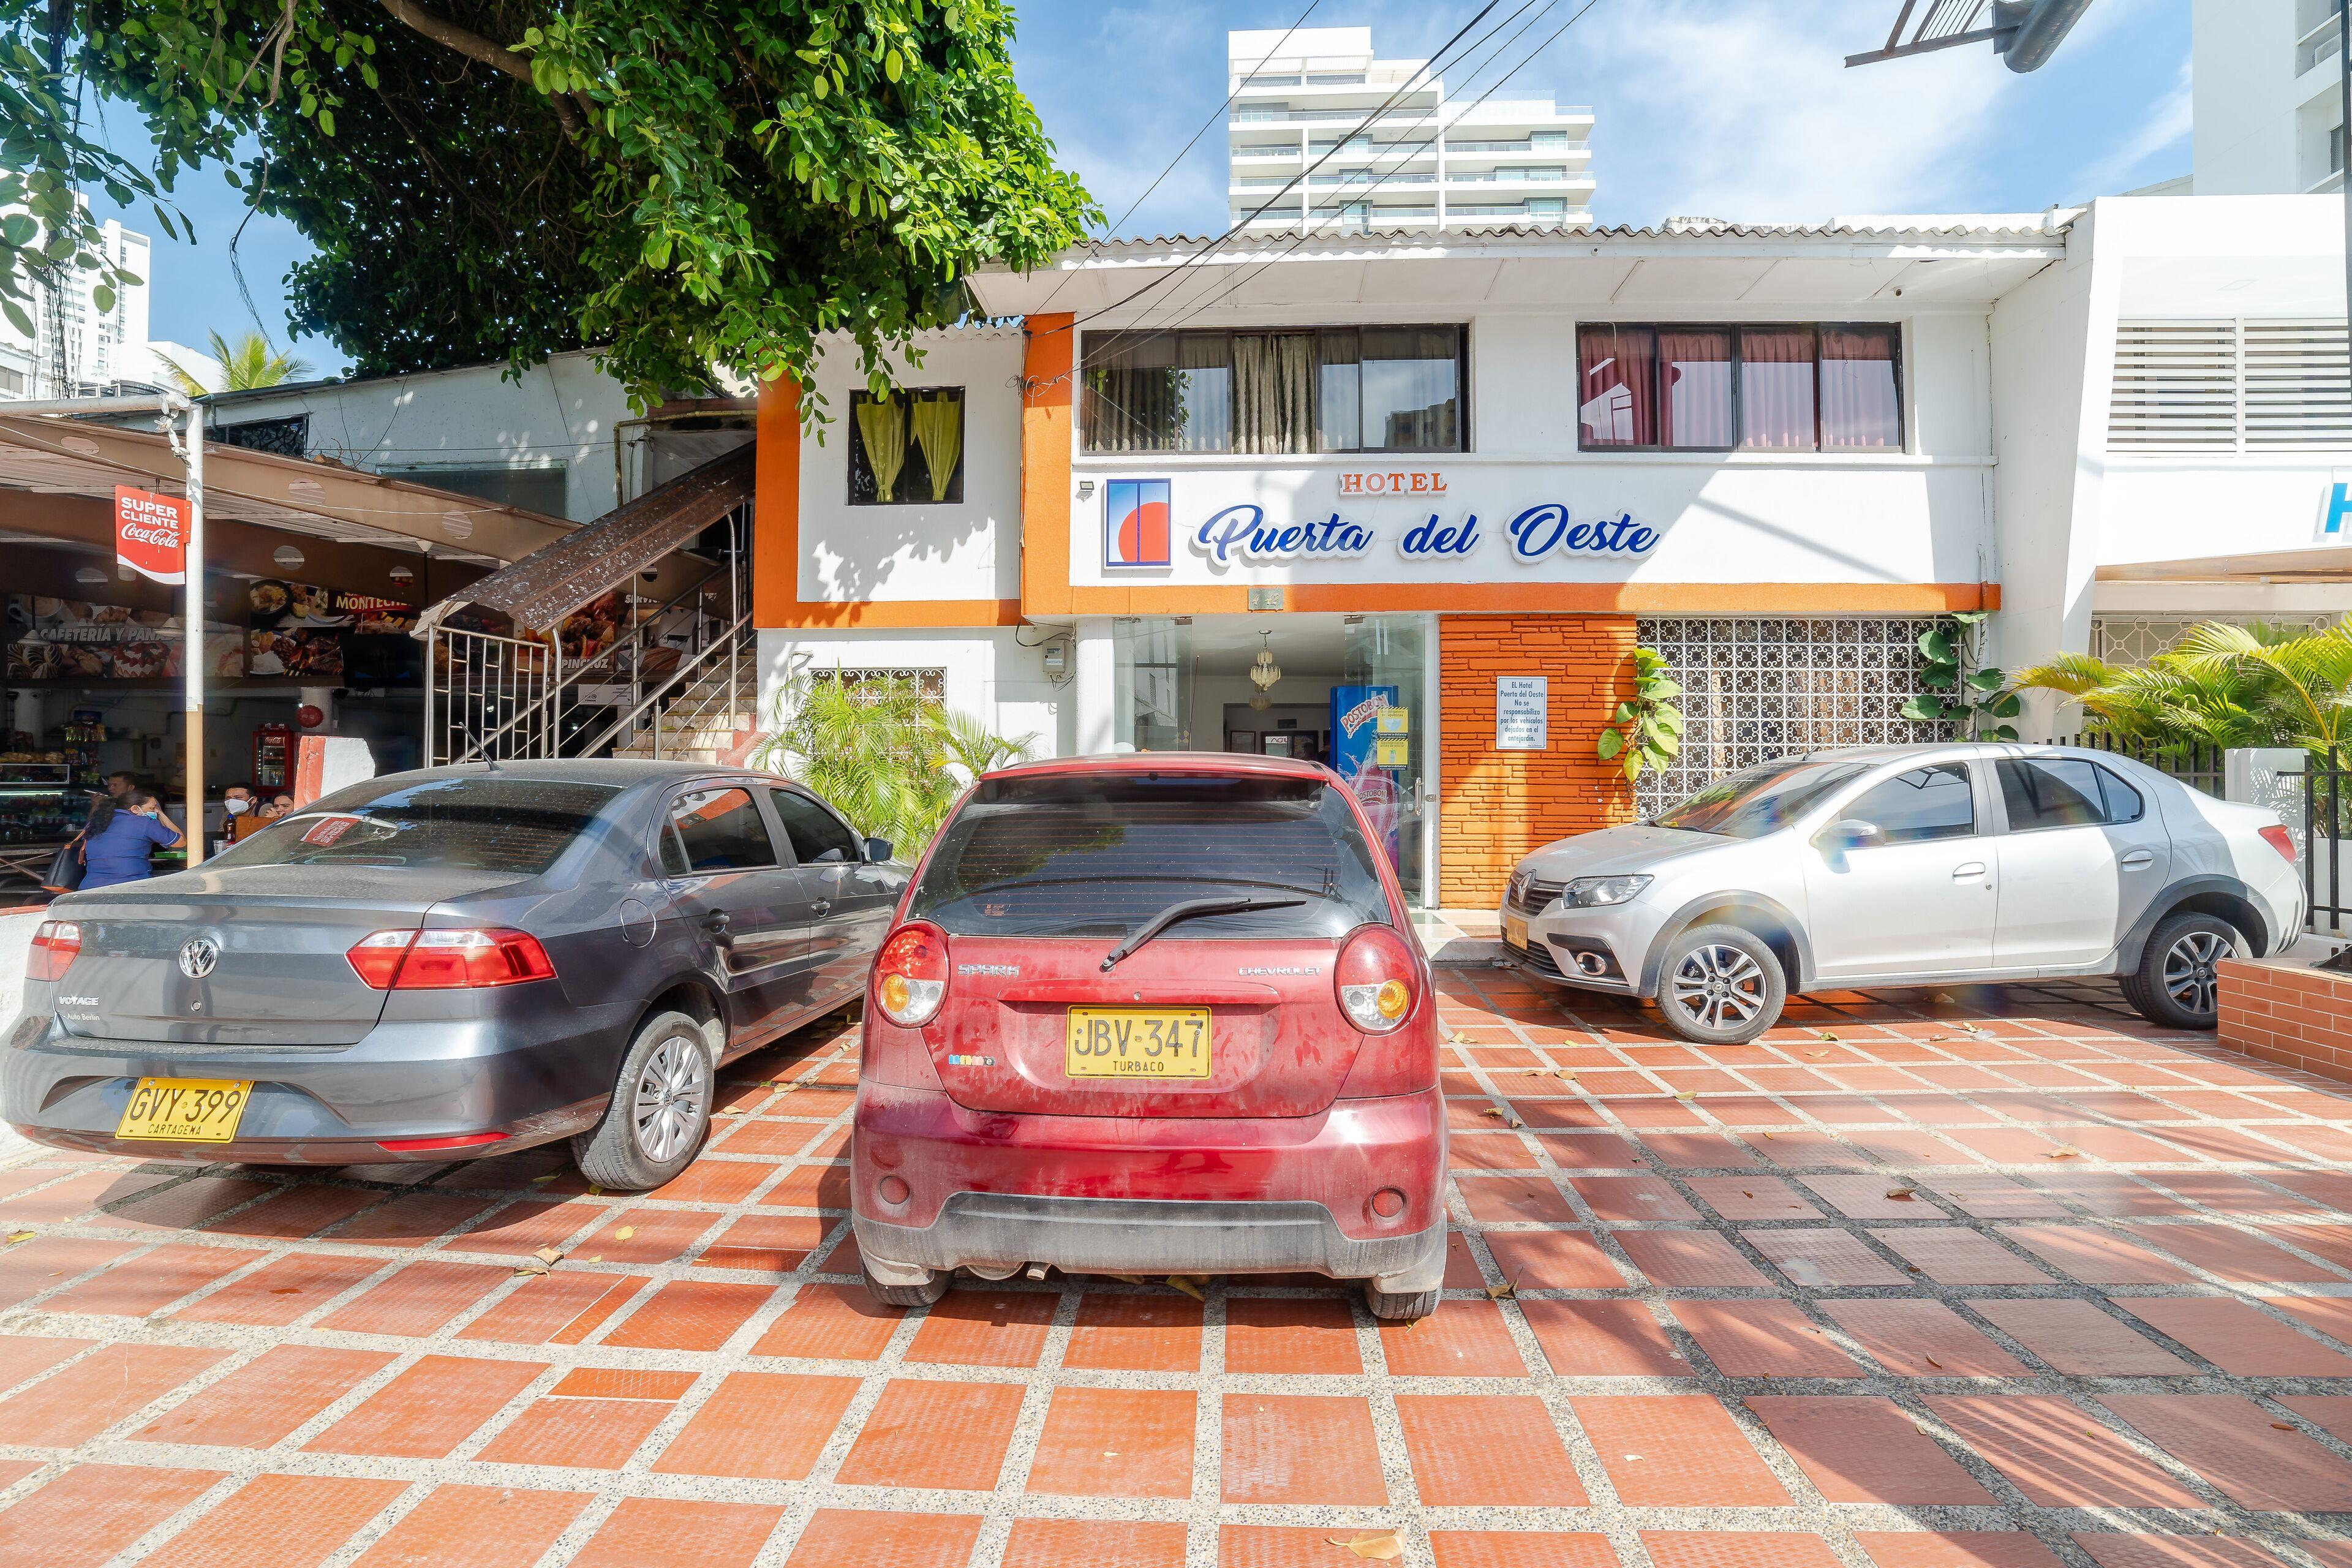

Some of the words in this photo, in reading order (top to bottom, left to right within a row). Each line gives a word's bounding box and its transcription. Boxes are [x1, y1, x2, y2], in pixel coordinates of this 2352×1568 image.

[1343, 473, 1447, 492] HOTEL
[121, 497, 178, 519] SUPER
[121, 510, 179, 529] CLIENTE
[121, 522, 181, 548] Coca-Cola
[1198, 505, 1373, 560] Puerta
[1403, 514, 1480, 554] del
[1510, 503, 1660, 556] Oeste
[115, 627, 125, 641] Y
[958, 964, 1020, 977] SPARK
[1238, 967, 1322, 976] CHEVROLET
[59, 996, 99, 1005] VOYAGE
[1075, 1020, 1132, 1056] JBV
[1145, 1020, 1204, 1057] 347
[1113, 1061, 1164, 1072] TURBACO
[130, 1088, 186, 1121] GVY
[185, 1090, 241, 1123] 399
[148, 1124, 202, 1135] CARTAGENA
